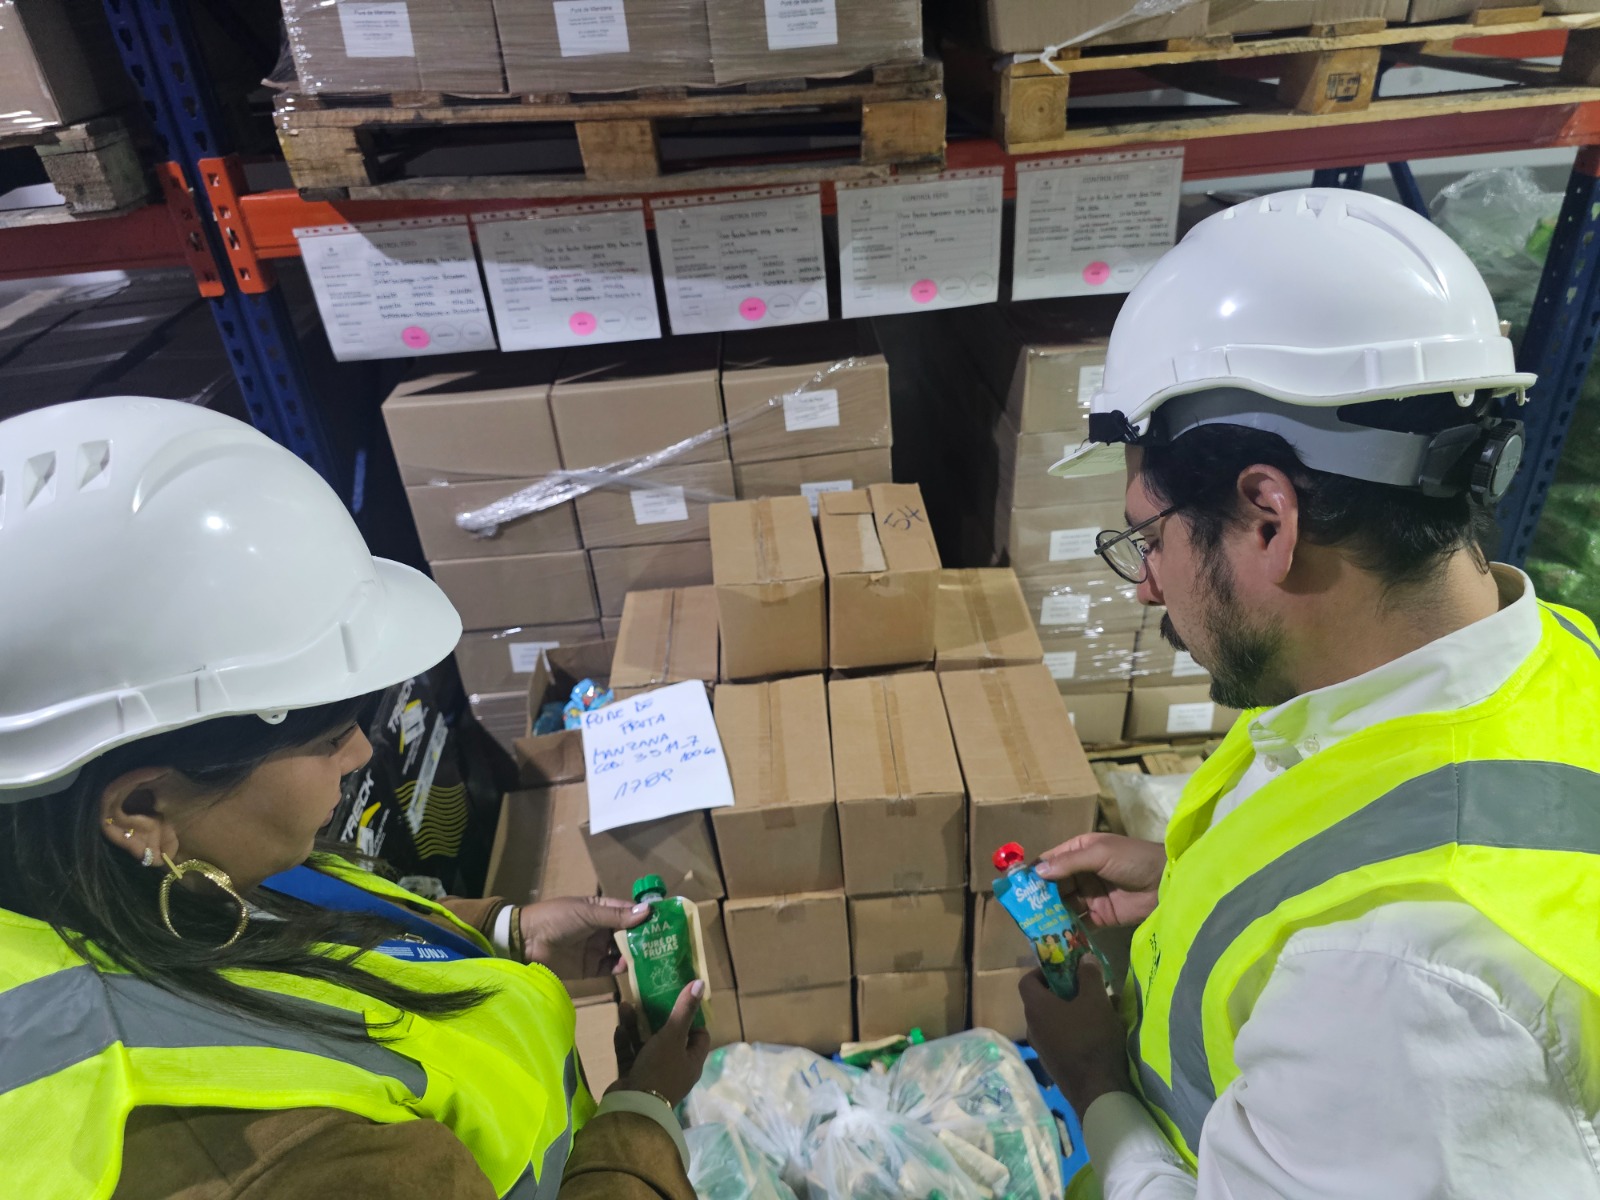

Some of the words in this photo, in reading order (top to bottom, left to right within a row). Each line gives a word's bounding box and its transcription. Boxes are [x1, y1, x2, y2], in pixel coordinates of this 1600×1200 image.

[642, 920, 671, 936] AMA
[665, 933, 678, 945] DE
[416, 946, 449, 959] JUNJI
[643, 942, 679, 959] FRUTAS
